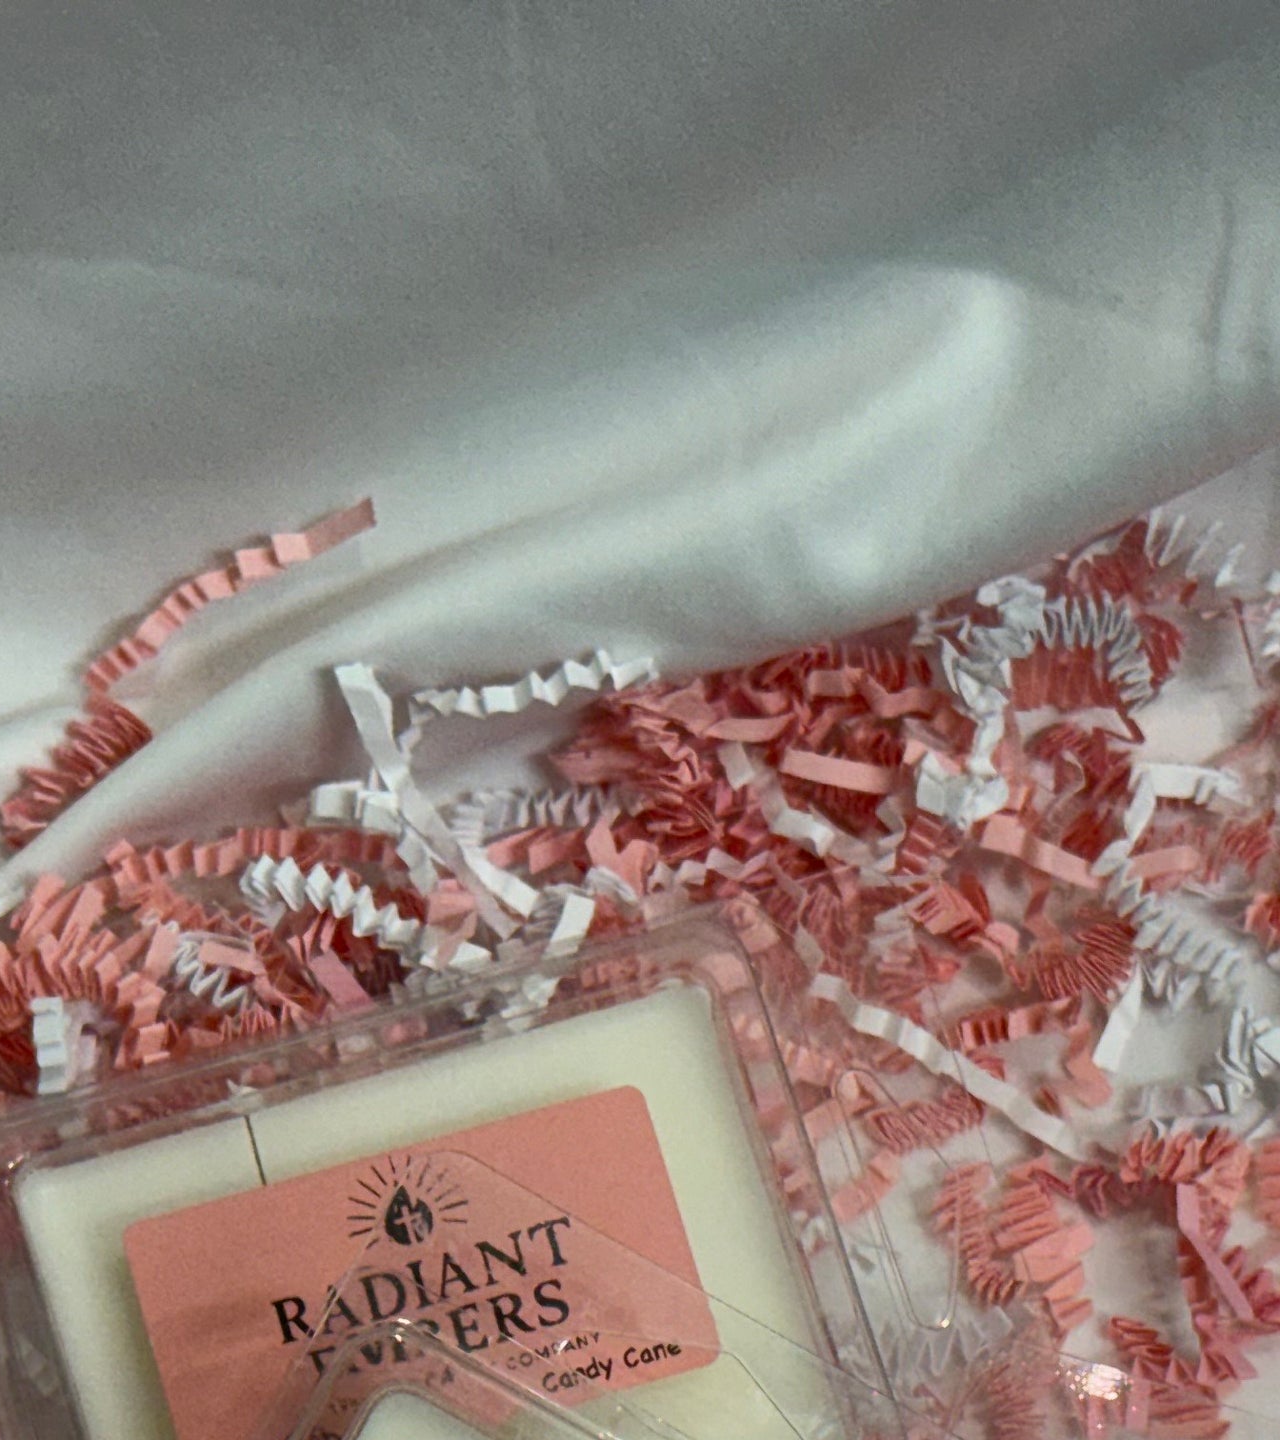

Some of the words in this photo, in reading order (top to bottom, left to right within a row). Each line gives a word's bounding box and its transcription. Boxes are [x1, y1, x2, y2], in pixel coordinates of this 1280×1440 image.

[272, 1217, 570, 1344] RADIANT
[542, 1357, 613, 1393] Candy
[623, 1343, 682, 1368] Cane
